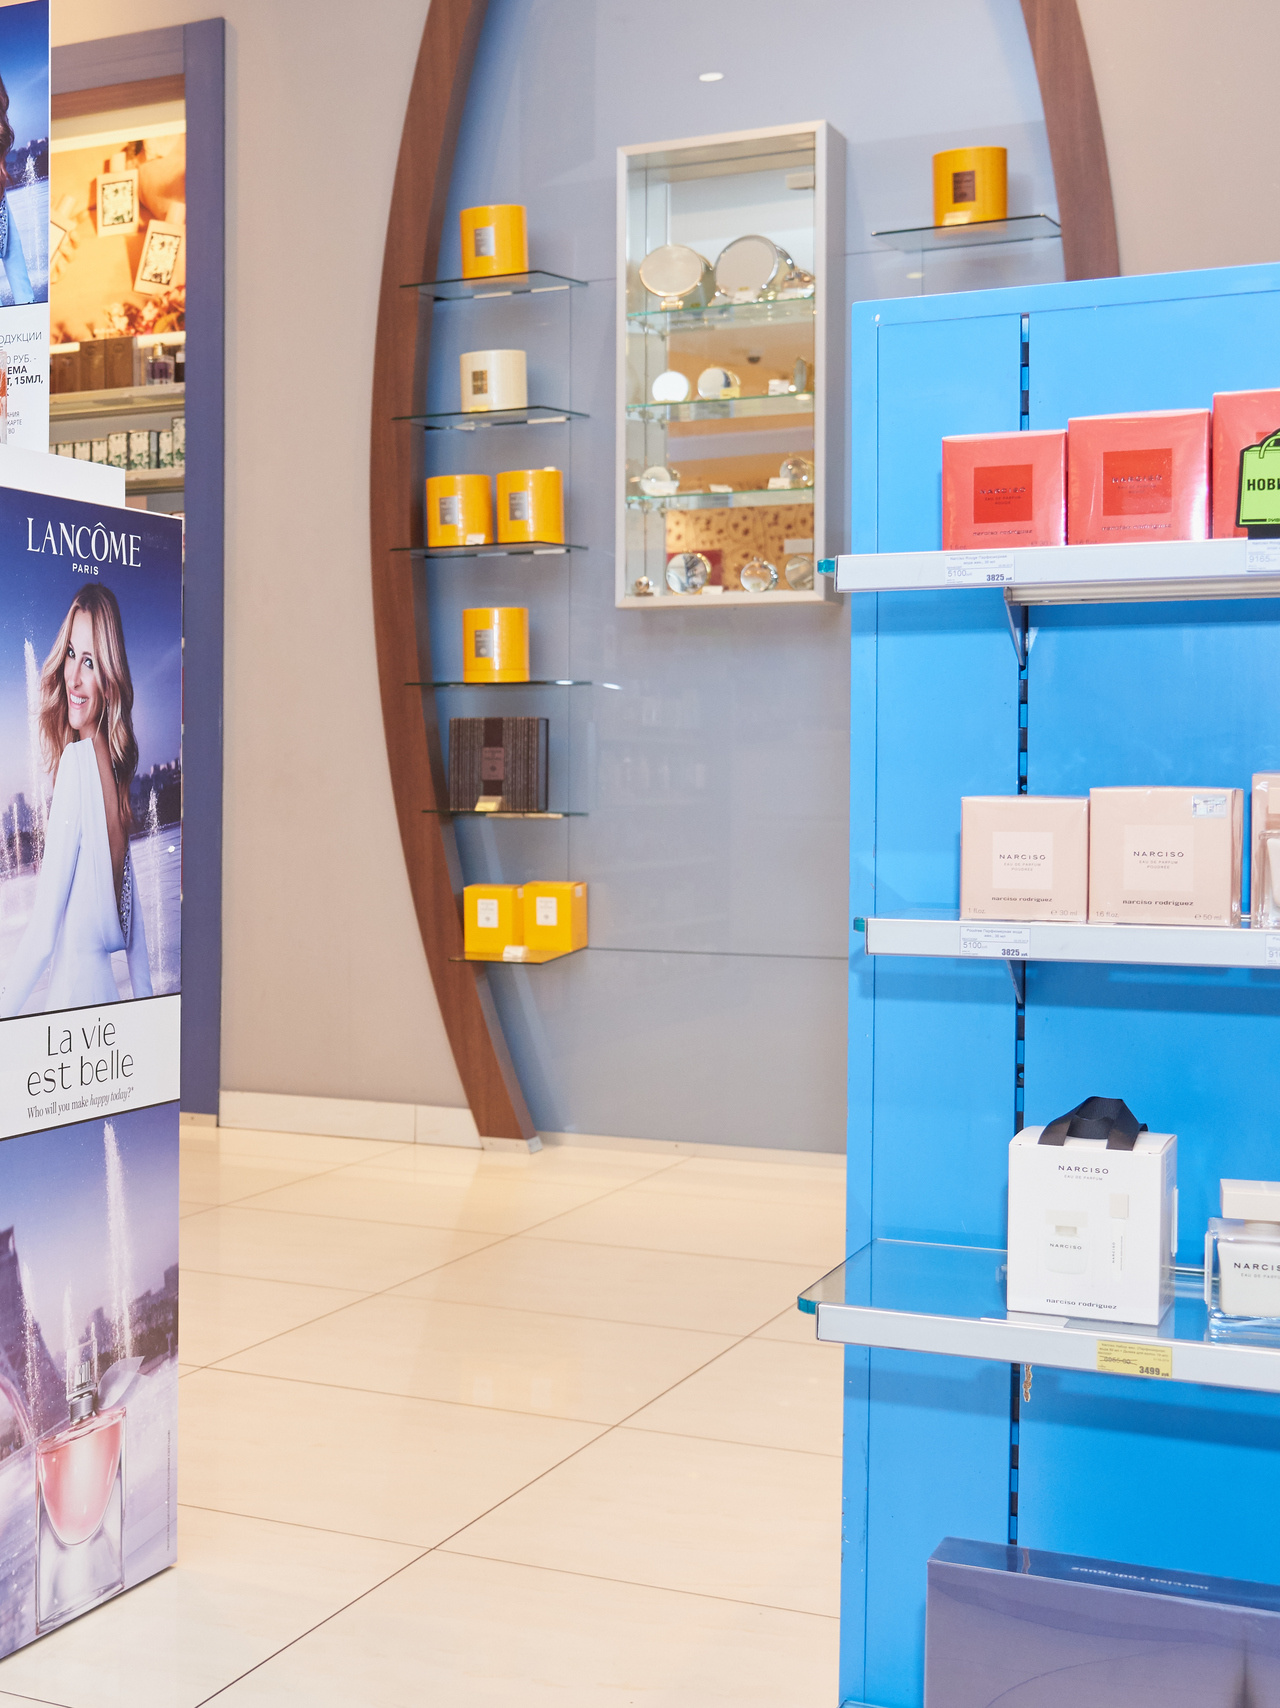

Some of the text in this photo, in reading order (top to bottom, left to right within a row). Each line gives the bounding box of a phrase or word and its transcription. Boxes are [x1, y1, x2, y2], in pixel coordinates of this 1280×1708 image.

[16, 375, 44, 384] 15МЛ,
[1112, 475, 1163, 483] NARCISO
[26, 517, 142, 568] LANCÔME
[71, 562, 100, 576] PARIS
[48, 1017, 115, 1056] La vie
[27, 1049, 133, 1096] est belle
[27, 1094, 109, 1119] Who will you make happy
[1058, 1165, 1109, 1175] NARCISO
[1046, 1298, 1117, 1310] narciso rodriguez
[1139, 1366, 1160, 1375] 3499
